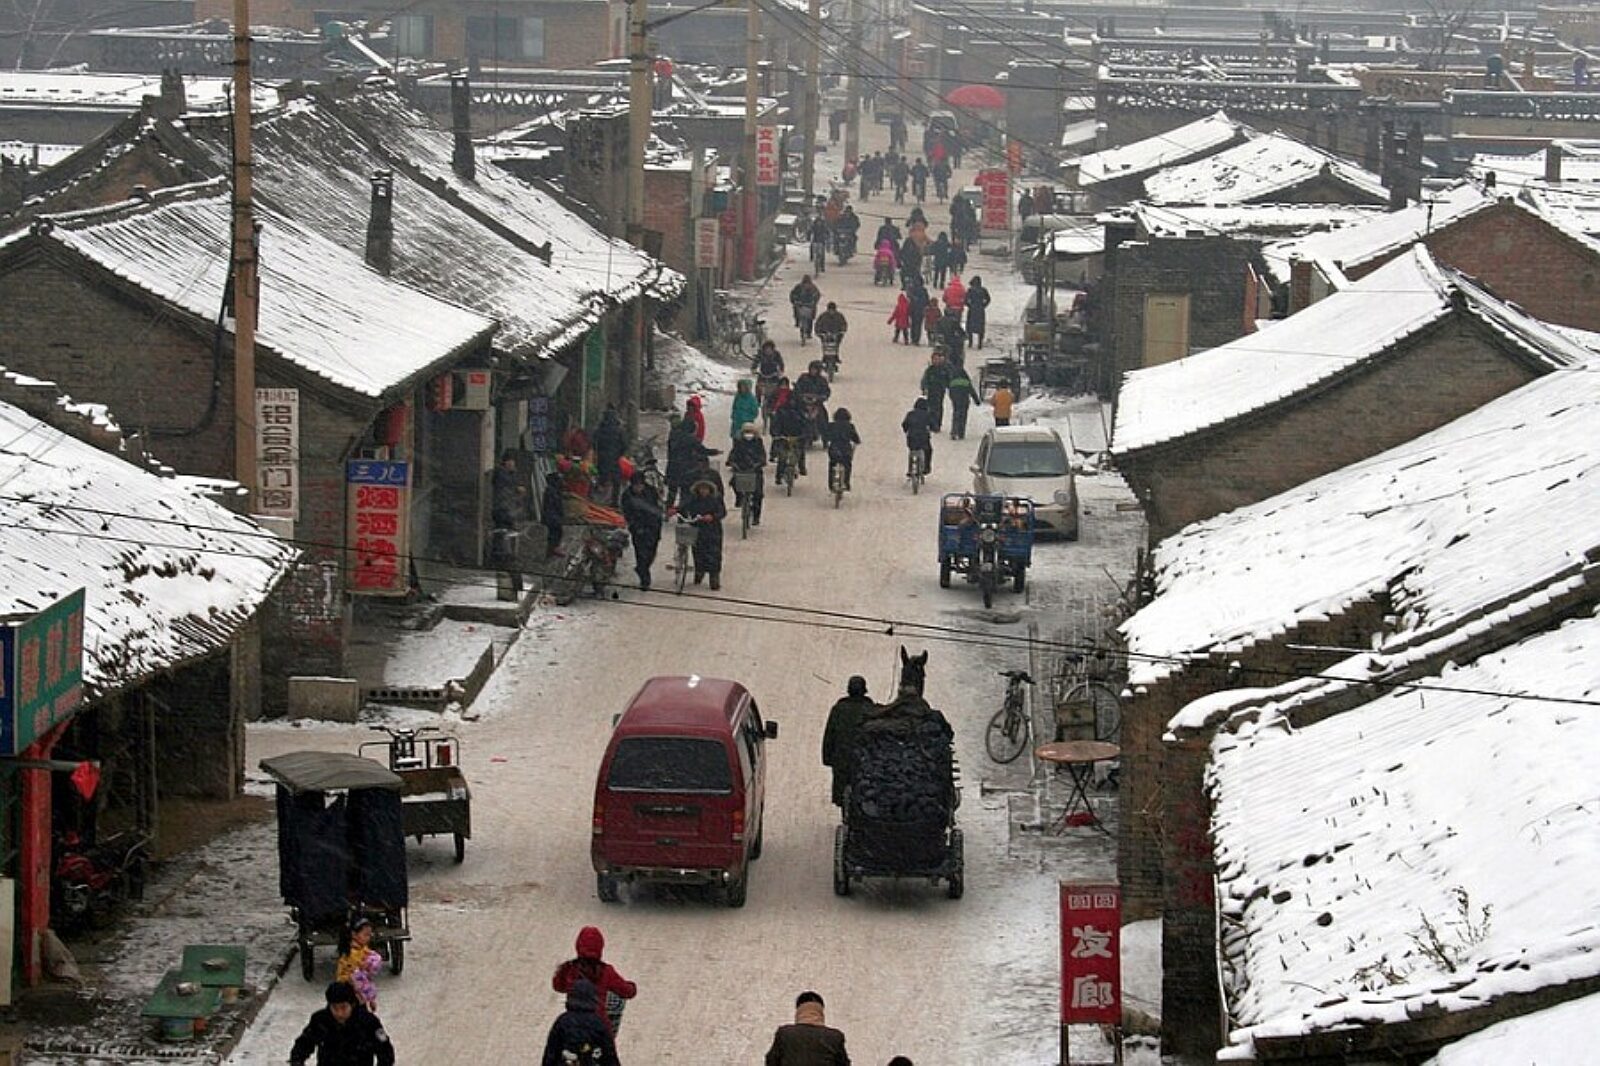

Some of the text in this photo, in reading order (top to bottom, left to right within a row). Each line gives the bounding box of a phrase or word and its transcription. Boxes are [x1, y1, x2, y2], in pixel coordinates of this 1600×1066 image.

[262, 405, 292, 509] 铝合金门窗
[1071, 924, 1115, 1010] 发廊
